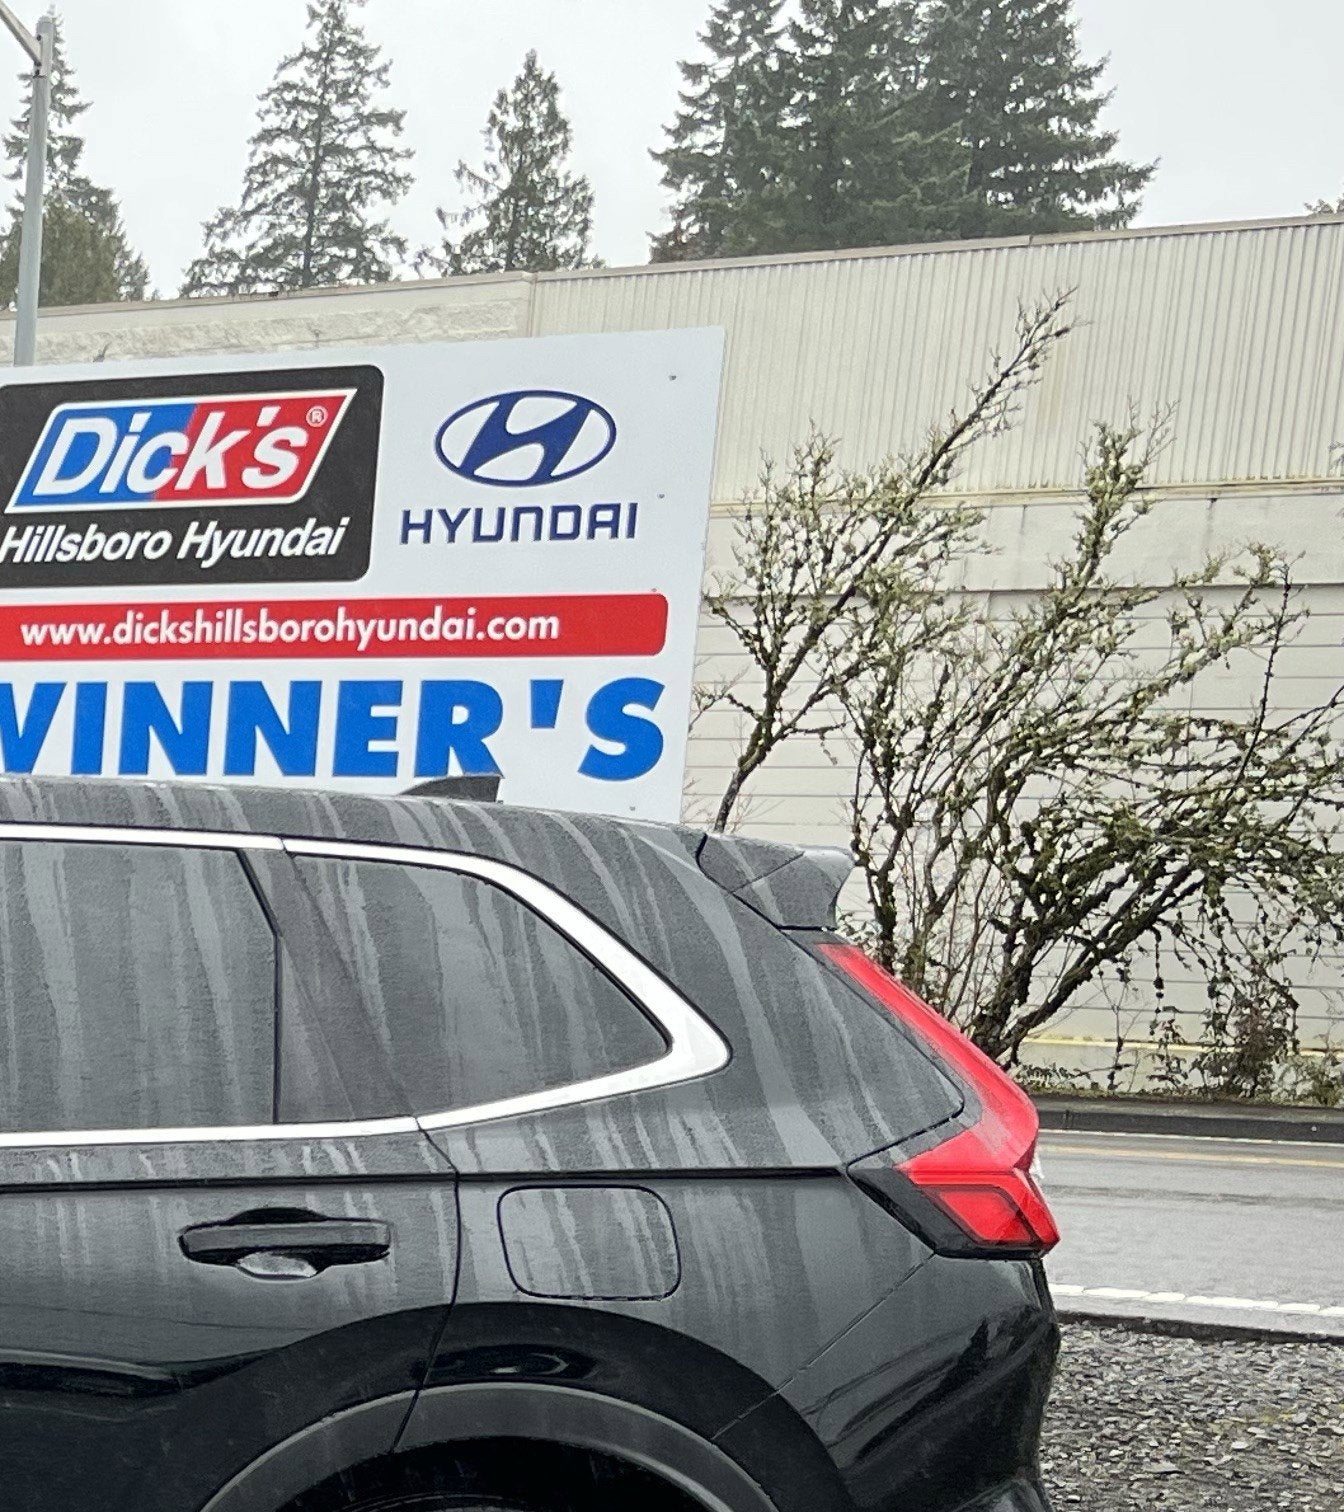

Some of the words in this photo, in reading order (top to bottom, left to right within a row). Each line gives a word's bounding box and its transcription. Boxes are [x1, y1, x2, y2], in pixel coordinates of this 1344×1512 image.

[32, 405, 310, 496] Dick's
[177, 517, 351, 568] Hyundai
[399, 502, 639, 545] HYUNDAI
[20, 604, 560, 651] www.dickshillsborohyundai.com
